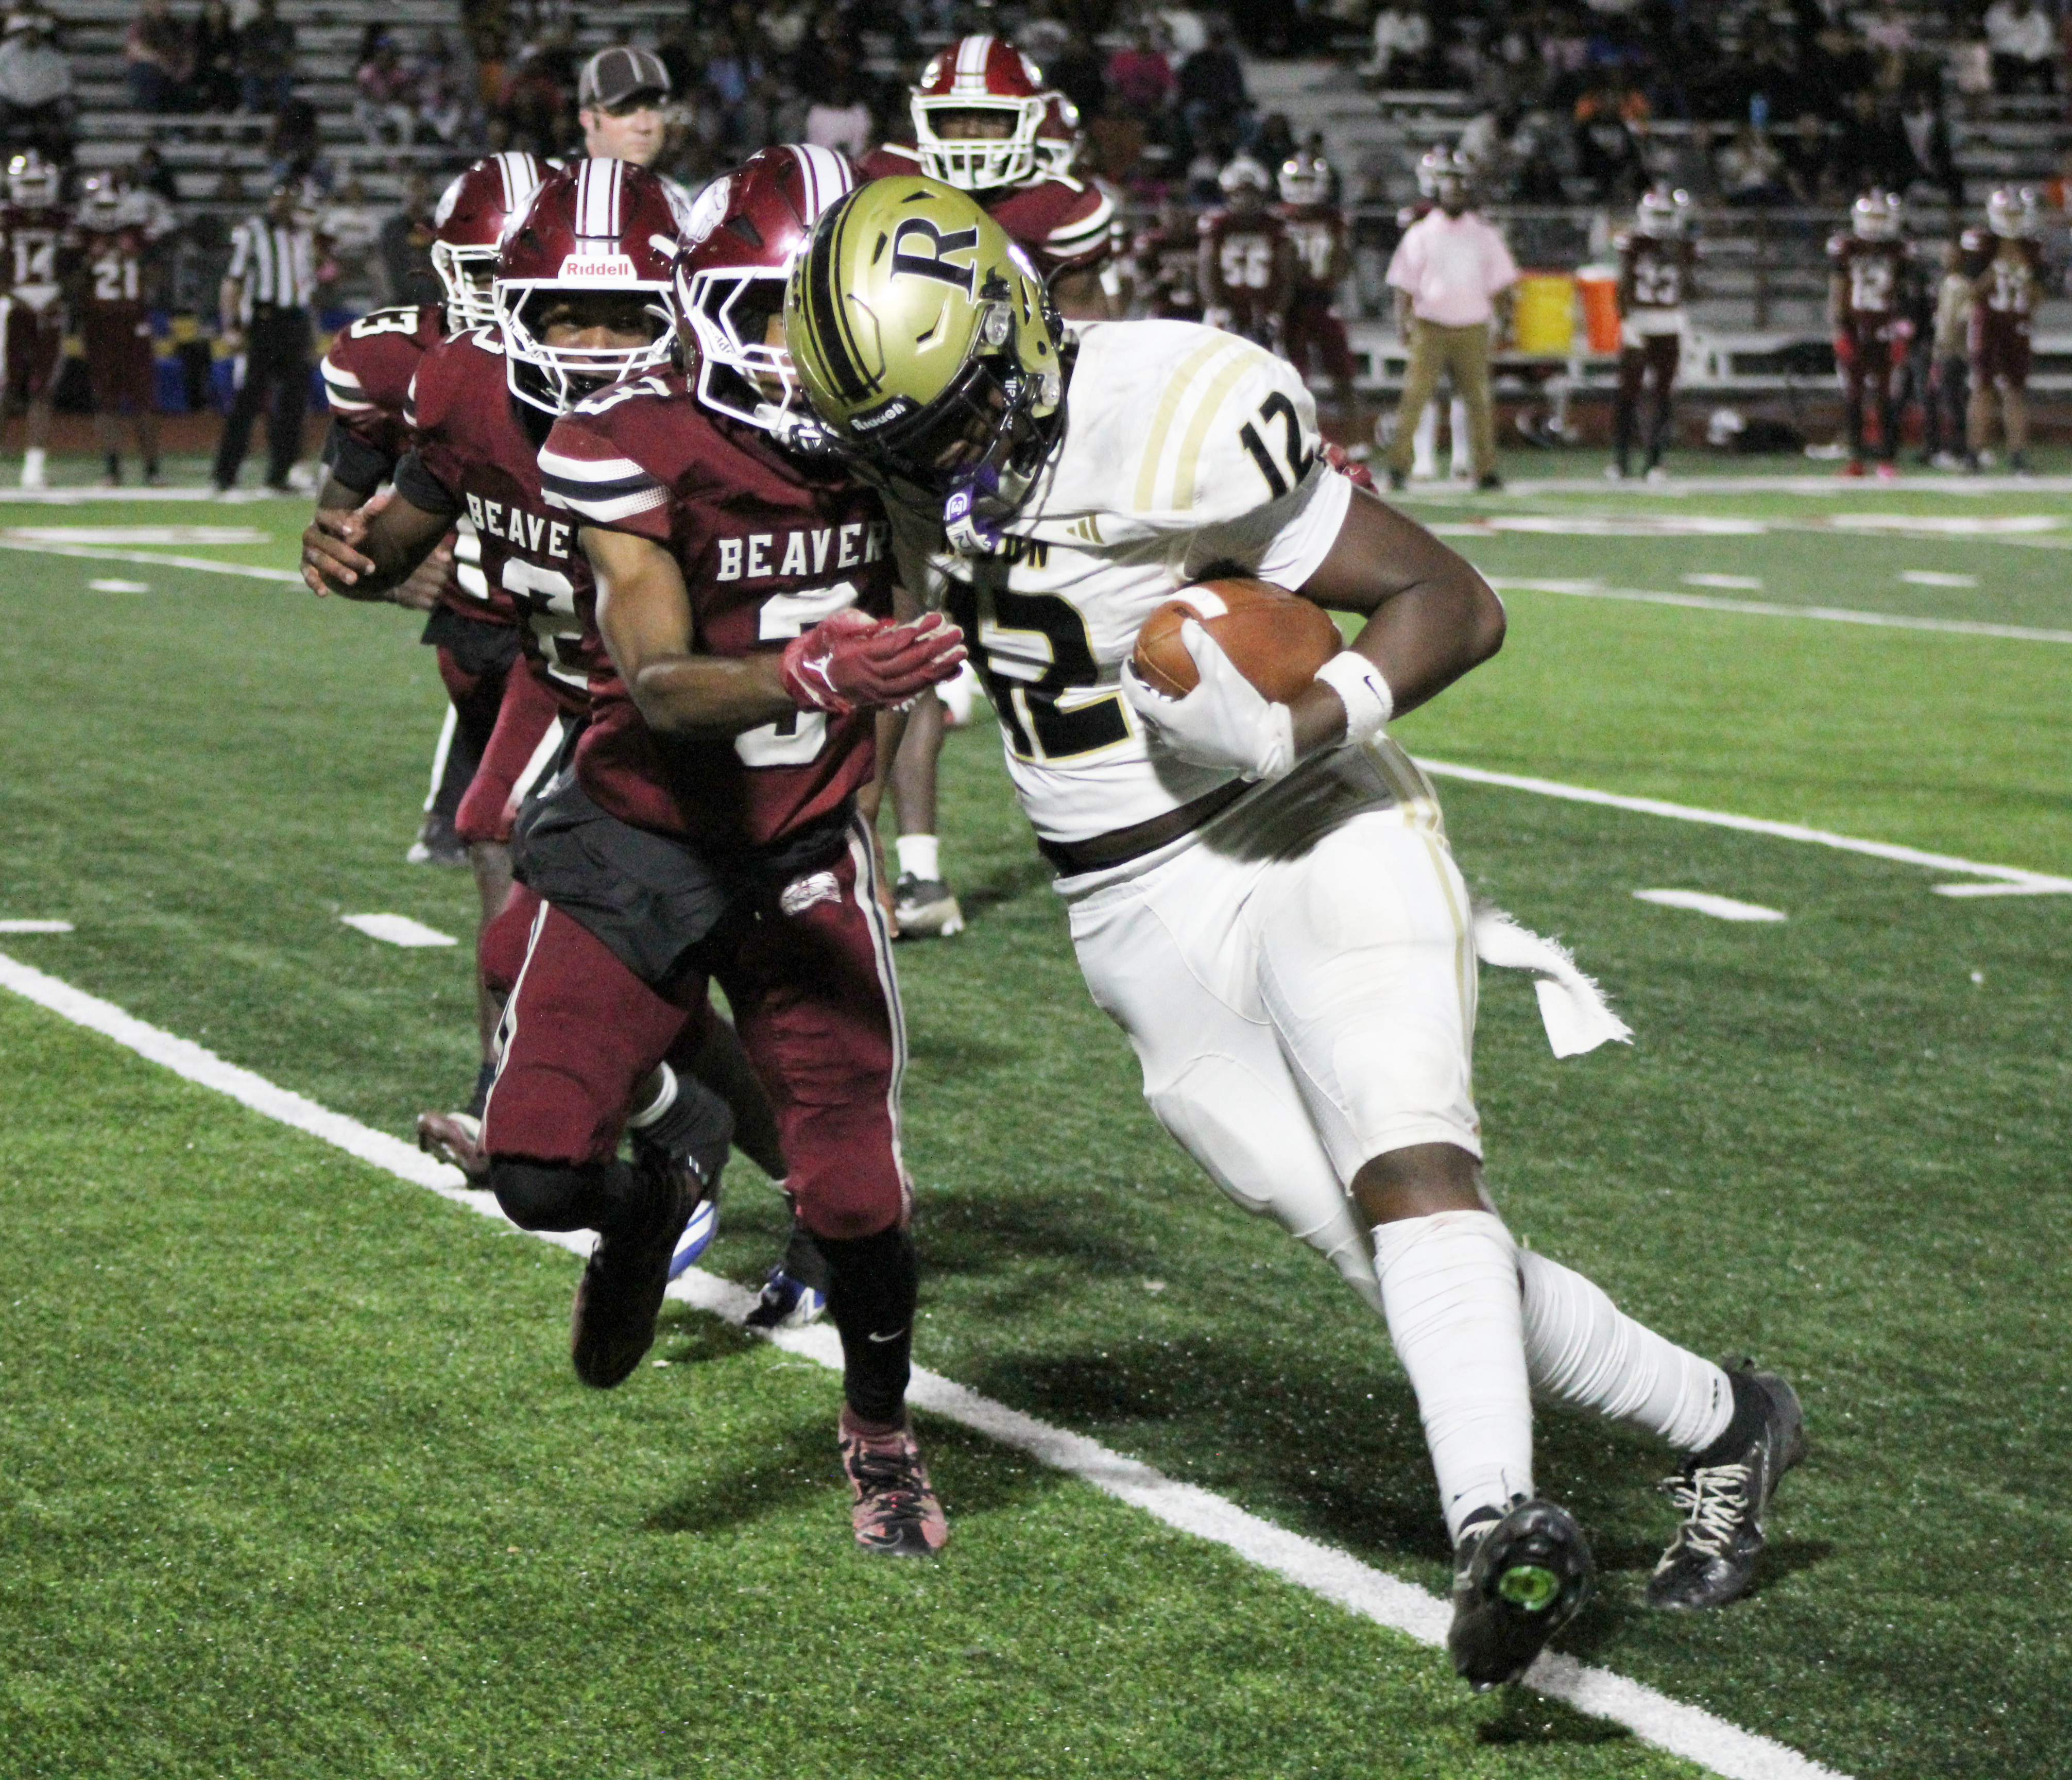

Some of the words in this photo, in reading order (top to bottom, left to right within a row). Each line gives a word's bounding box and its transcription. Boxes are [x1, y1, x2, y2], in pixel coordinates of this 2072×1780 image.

[93, 259, 138, 299] 21
[567, 263, 628, 276] Riddell
[891, 217, 979, 304] R
[1237, 389, 1315, 502] 12
[947, 573, 1136, 764] 12
